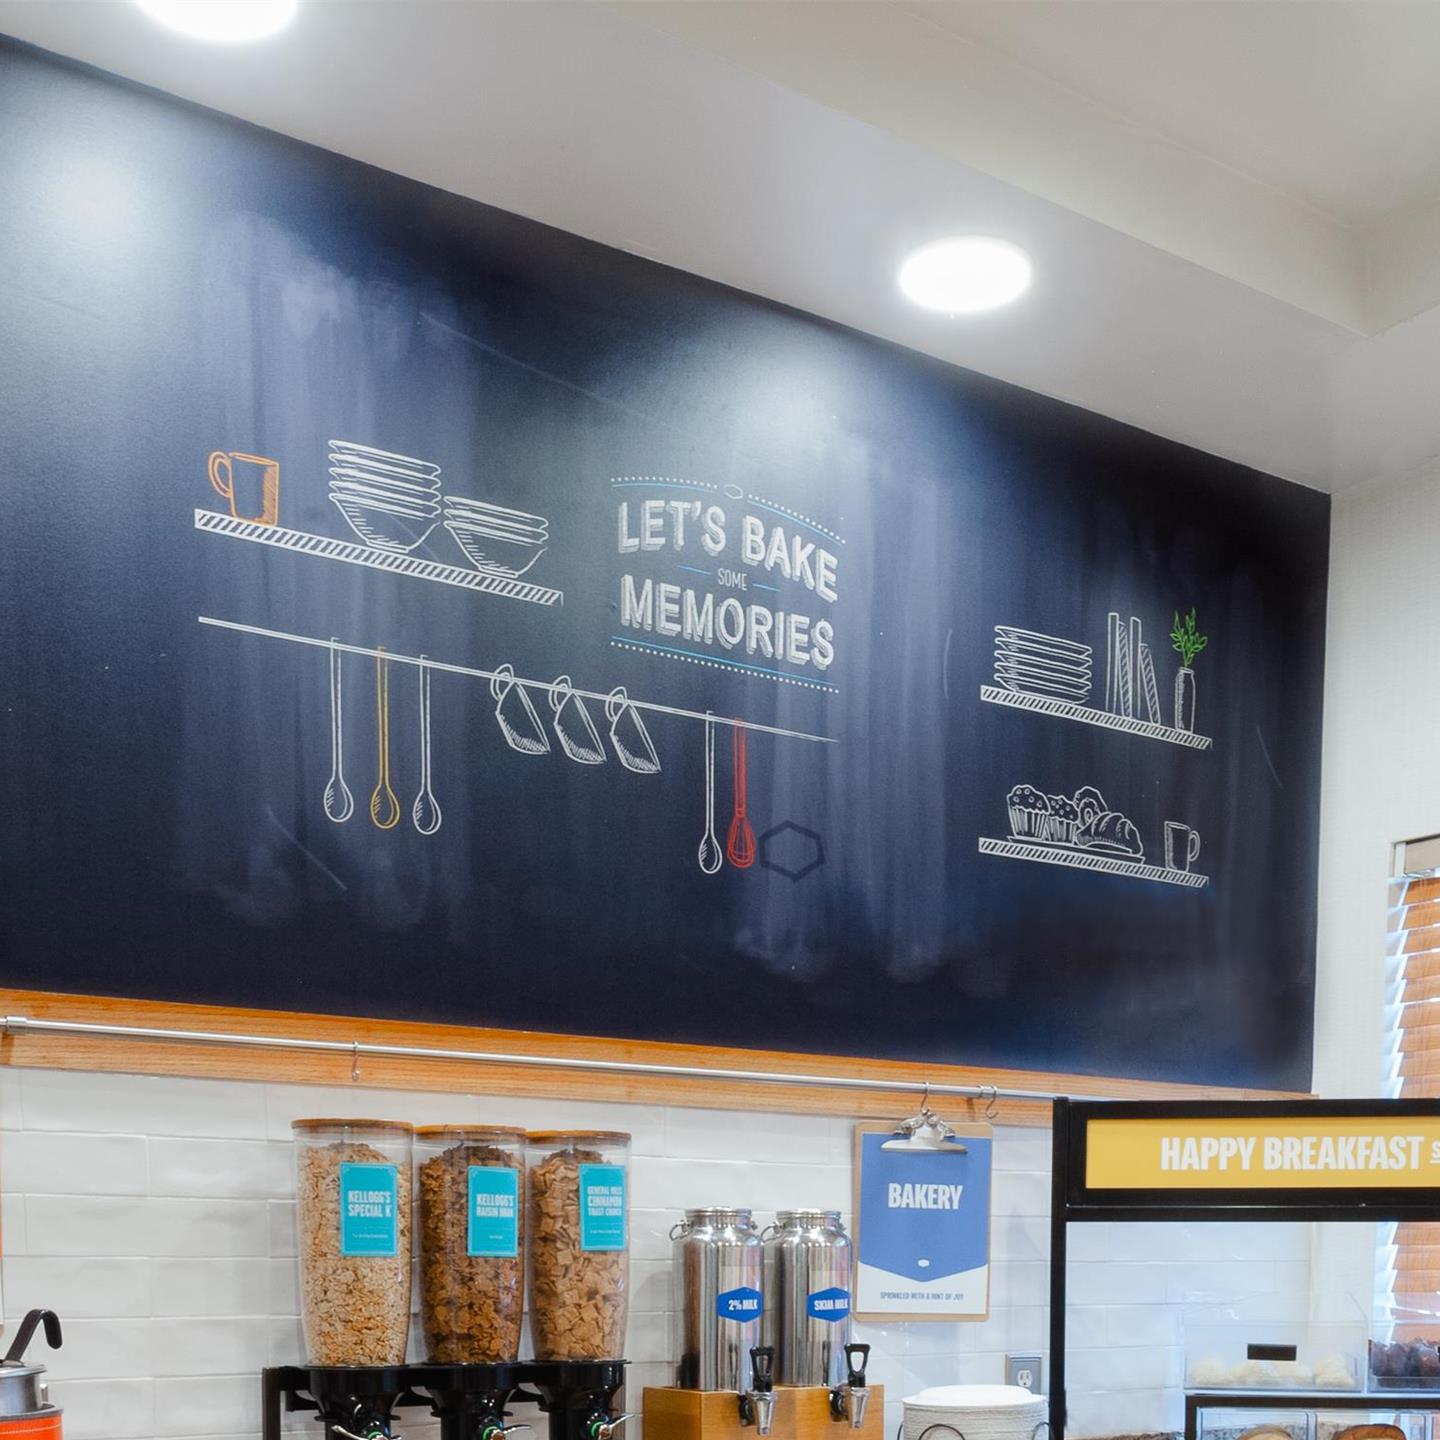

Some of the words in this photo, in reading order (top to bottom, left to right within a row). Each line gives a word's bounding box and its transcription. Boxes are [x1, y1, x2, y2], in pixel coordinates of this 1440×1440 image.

[618, 500, 726, 556] LET'S
[741, 515, 838, 603] BAKE
[718, 568, 748, 591] SOME
[621, 574, 834, 670] MEMORIES
[1161, 1137, 1256, 1170] HAPPY
[1263, 1135, 1424, 1170] BREAKFAST
[888, 1183, 963, 1209] BAKERY
[348, 1203, 383, 1216] SPECIAL
[385, 1204, 393, 1216] K
[728, 1299, 742, 1311] 2%
[742, 1299, 758, 1311] MILK
[814, 1299, 834, 1311] SKIM
[834, 1298, 849, 1310] MILK
